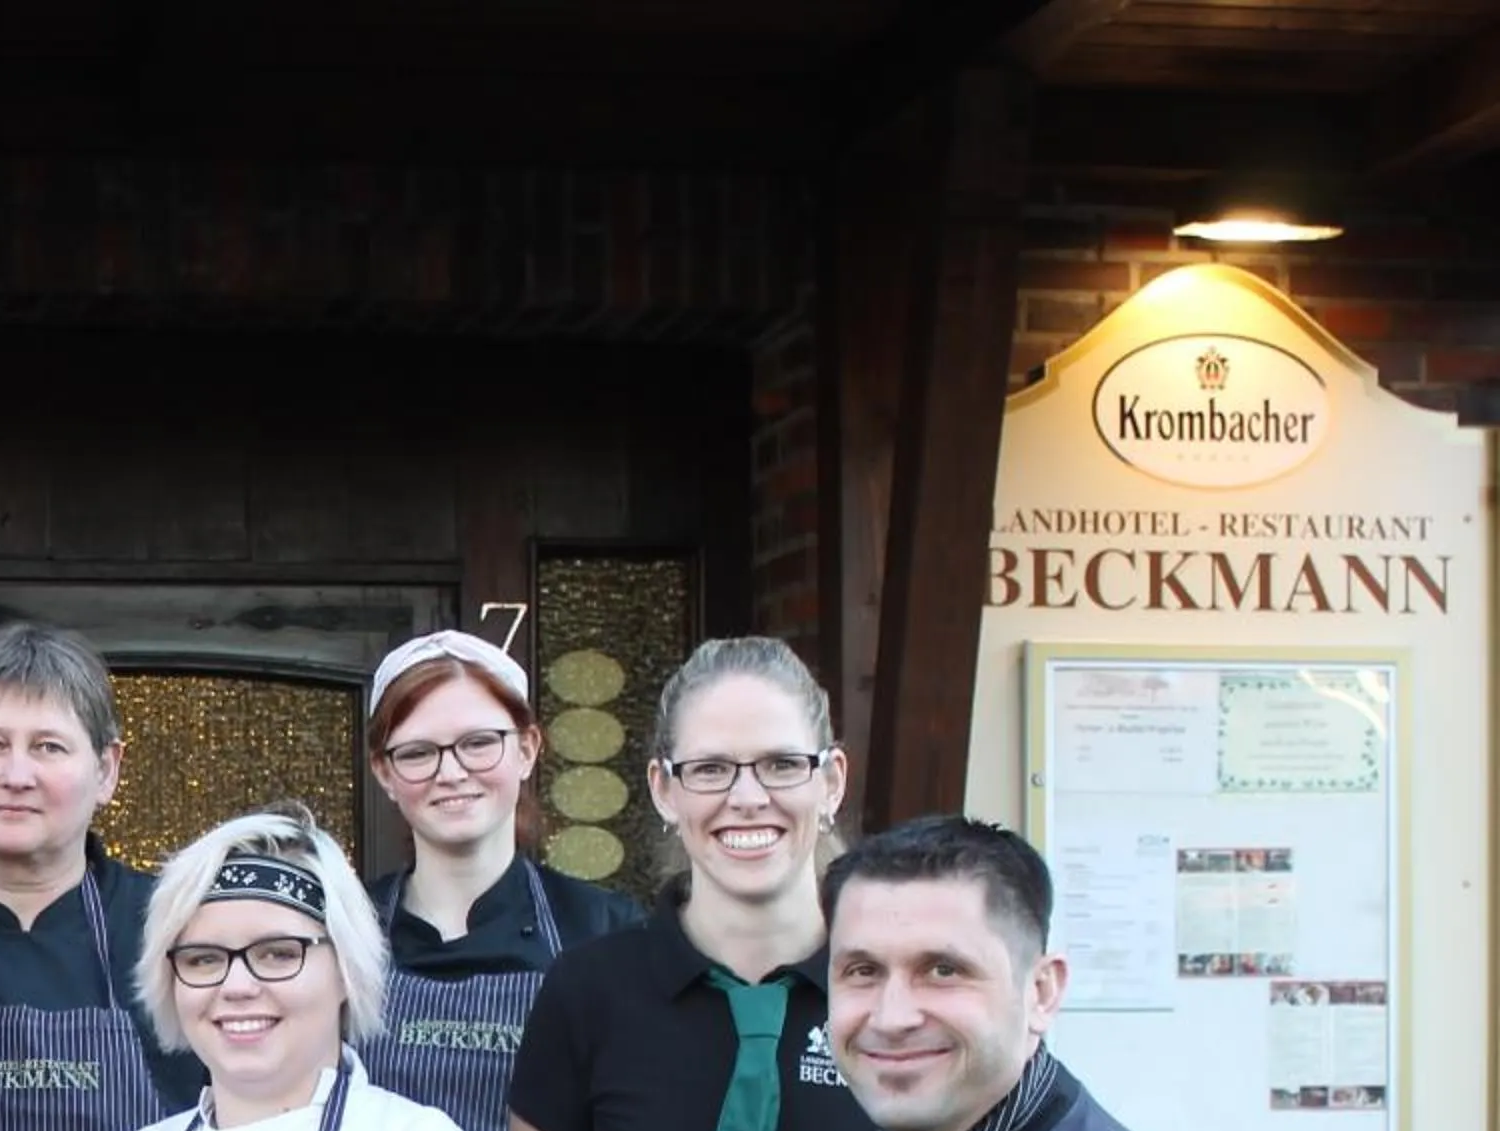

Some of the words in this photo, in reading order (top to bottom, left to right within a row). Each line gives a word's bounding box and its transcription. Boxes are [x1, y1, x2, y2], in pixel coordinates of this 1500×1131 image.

[1118, 394, 1316, 444] Krombacher
[1219, 512, 1434, 542] RESTAURANT
[983, 547, 1454, 616] BECKMANN
[481, 602, 528, 653] 7
[800, 1065, 848, 1088] BECK
